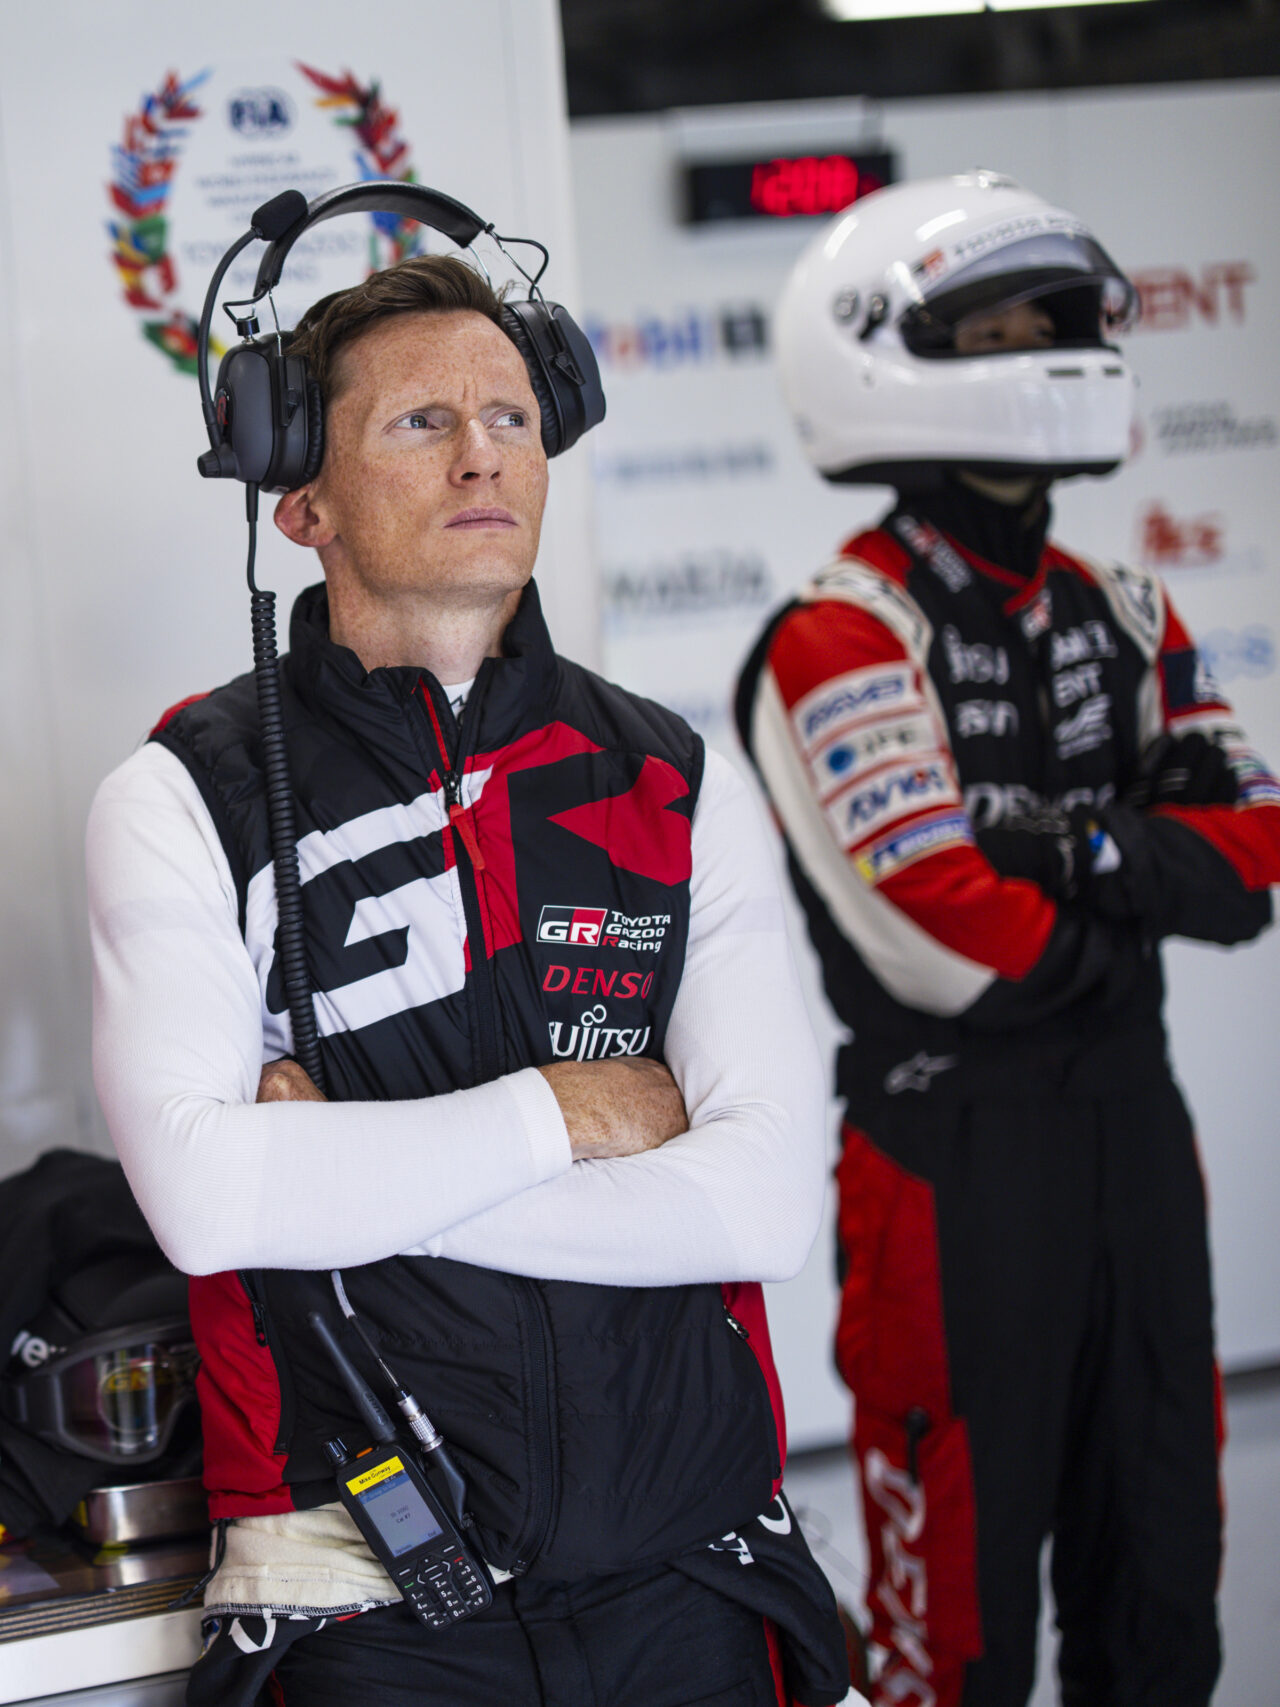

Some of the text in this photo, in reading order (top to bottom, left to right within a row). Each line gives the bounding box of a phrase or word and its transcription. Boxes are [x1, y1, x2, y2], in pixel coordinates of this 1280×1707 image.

[611, 910, 671, 928] TOYOTA
[539, 921, 599, 944] GR
[605, 923, 666, 939] GAZOO
[601, 935, 662, 954] Racing
[542, 964, 655, 1000] DENSO
